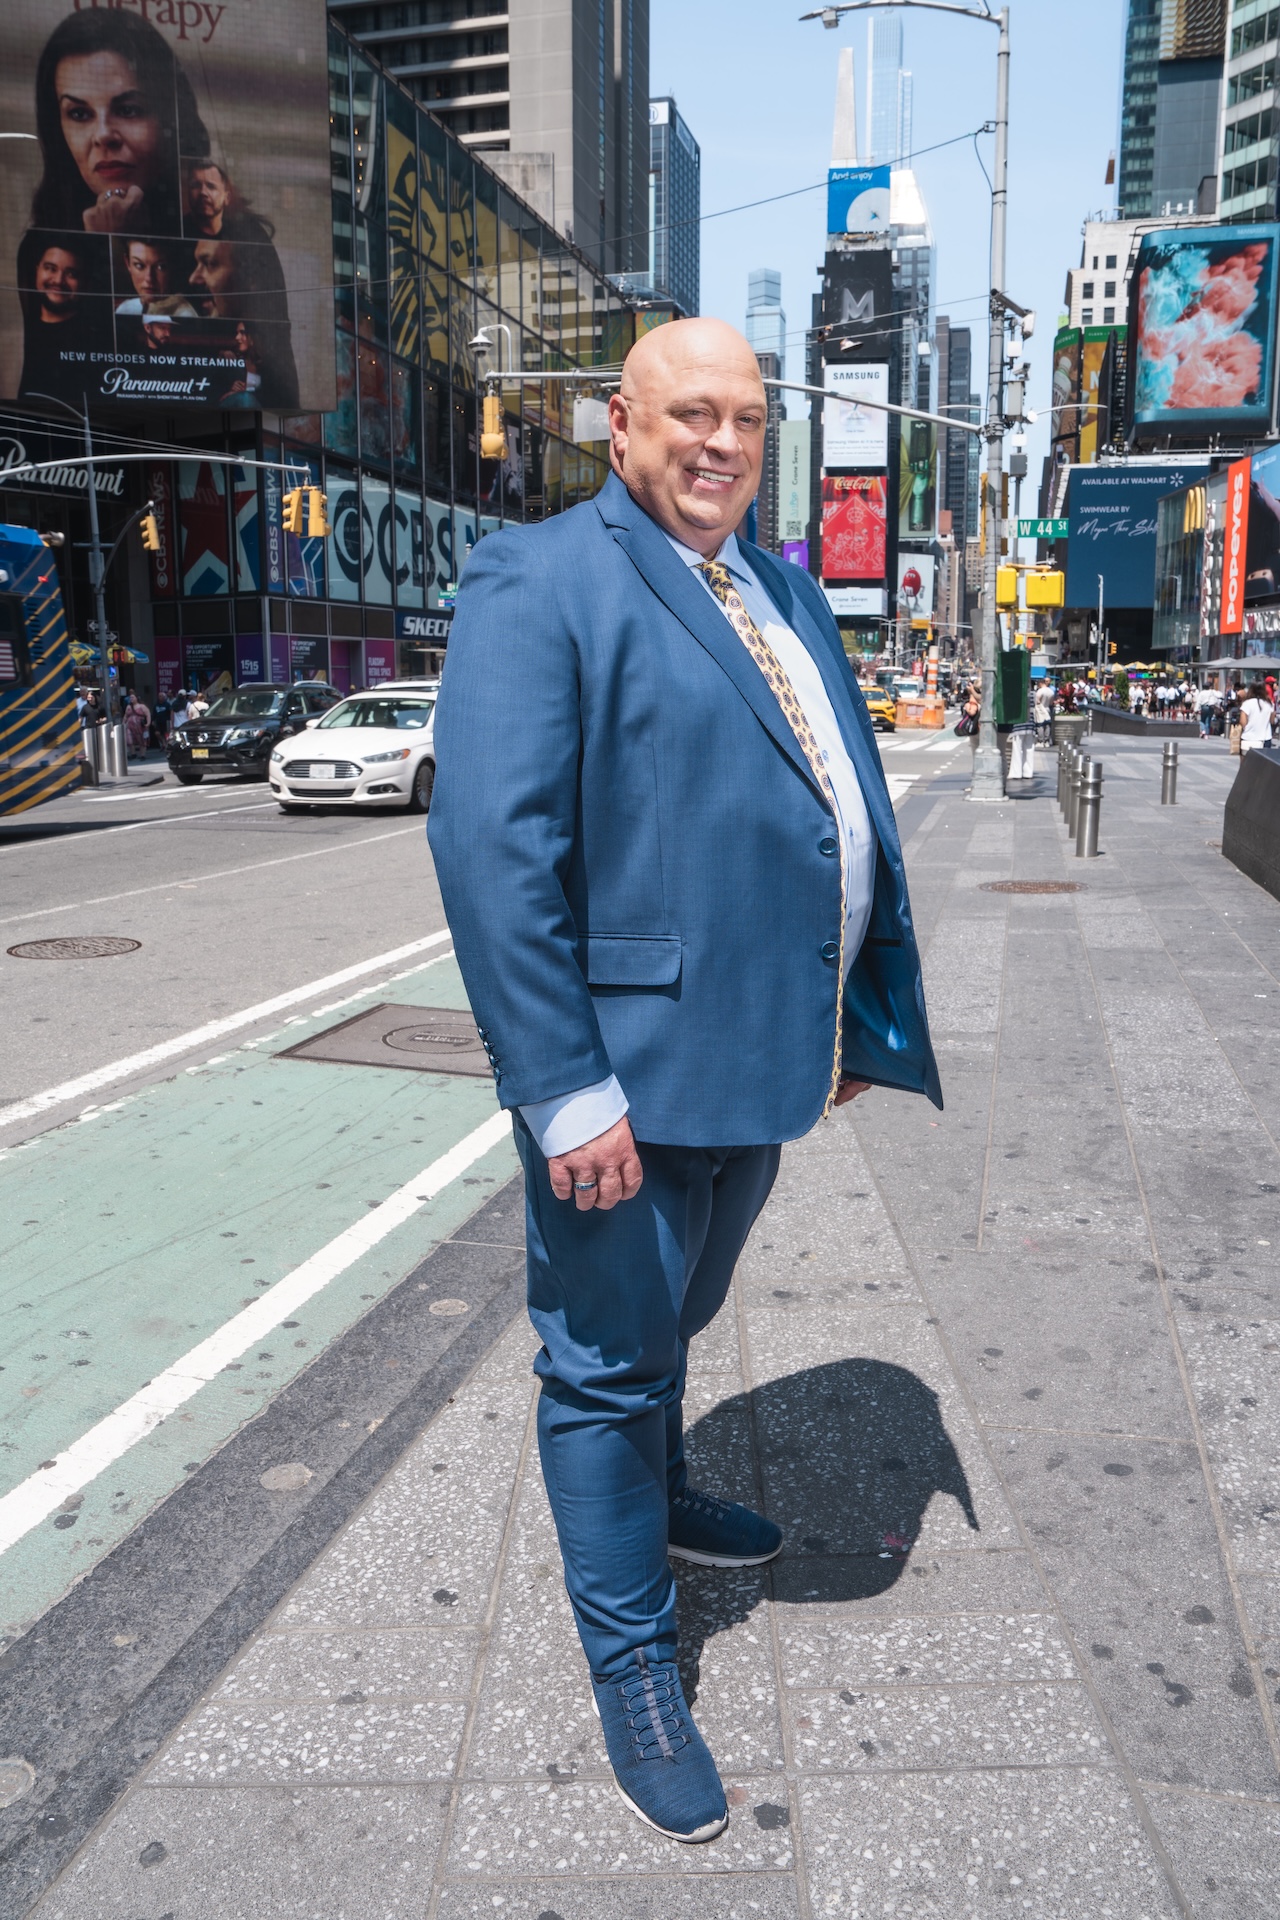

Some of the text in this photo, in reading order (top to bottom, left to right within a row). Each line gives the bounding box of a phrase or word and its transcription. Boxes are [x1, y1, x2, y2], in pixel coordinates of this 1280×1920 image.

[831, 171, 849, 180] And
[60, 351, 246, 368] NEW EPISODES NOW STREAMING
[100, 367, 211, 395] Paramount+
[833, 371, 880, 380] SAMSUNG
[1130, 477, 1167, 485] WALMART
[1079, 505, 1130, 514] SWIMWEAR BY
[1020, 520, 1067, 536] W 44 St
[269, 526, 279, 565] CBS
[377, 502, 458, 591] CBS
[1226, 472, 1244, 625] POPEYES
